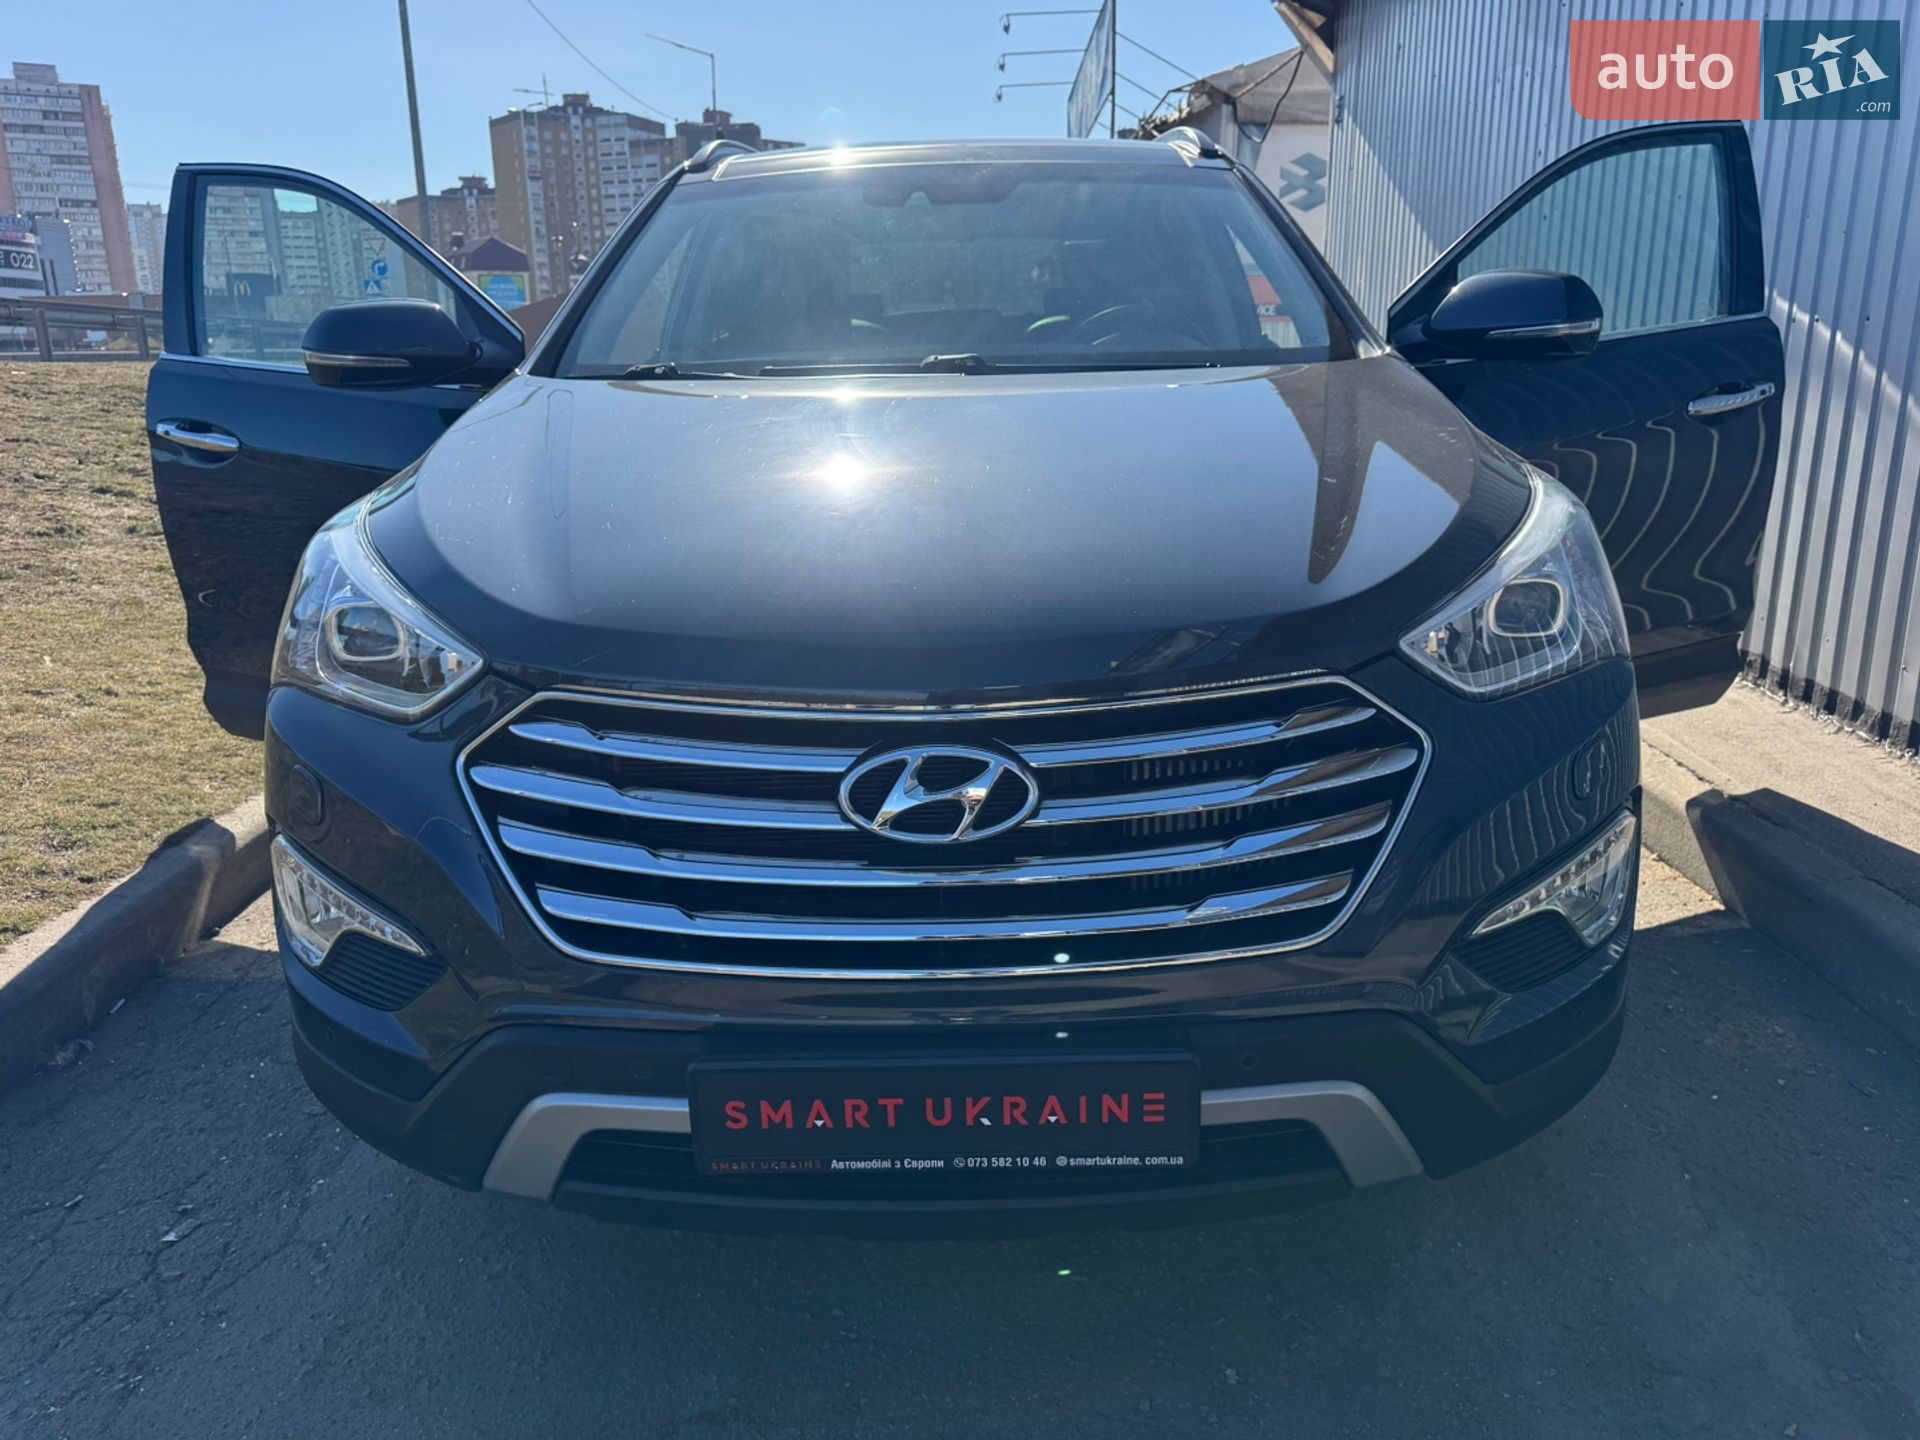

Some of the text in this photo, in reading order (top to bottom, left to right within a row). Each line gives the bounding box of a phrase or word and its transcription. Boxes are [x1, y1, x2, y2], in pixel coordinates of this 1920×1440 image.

[725, 1093, 1165, 1130] SMART UKRAINE
[711, 1161, 756, 1171] SMART
[830, 1158, 892, 1169] Автомобілі
[903, 1158, 945, 1170] Європи
[967, 1157, 988, 1168] 073
[991, 1157, 1012, 1168] 582
[1016, 1157, 1030, 1168] 10
[1032, 1156, 1047, 1167] 46
